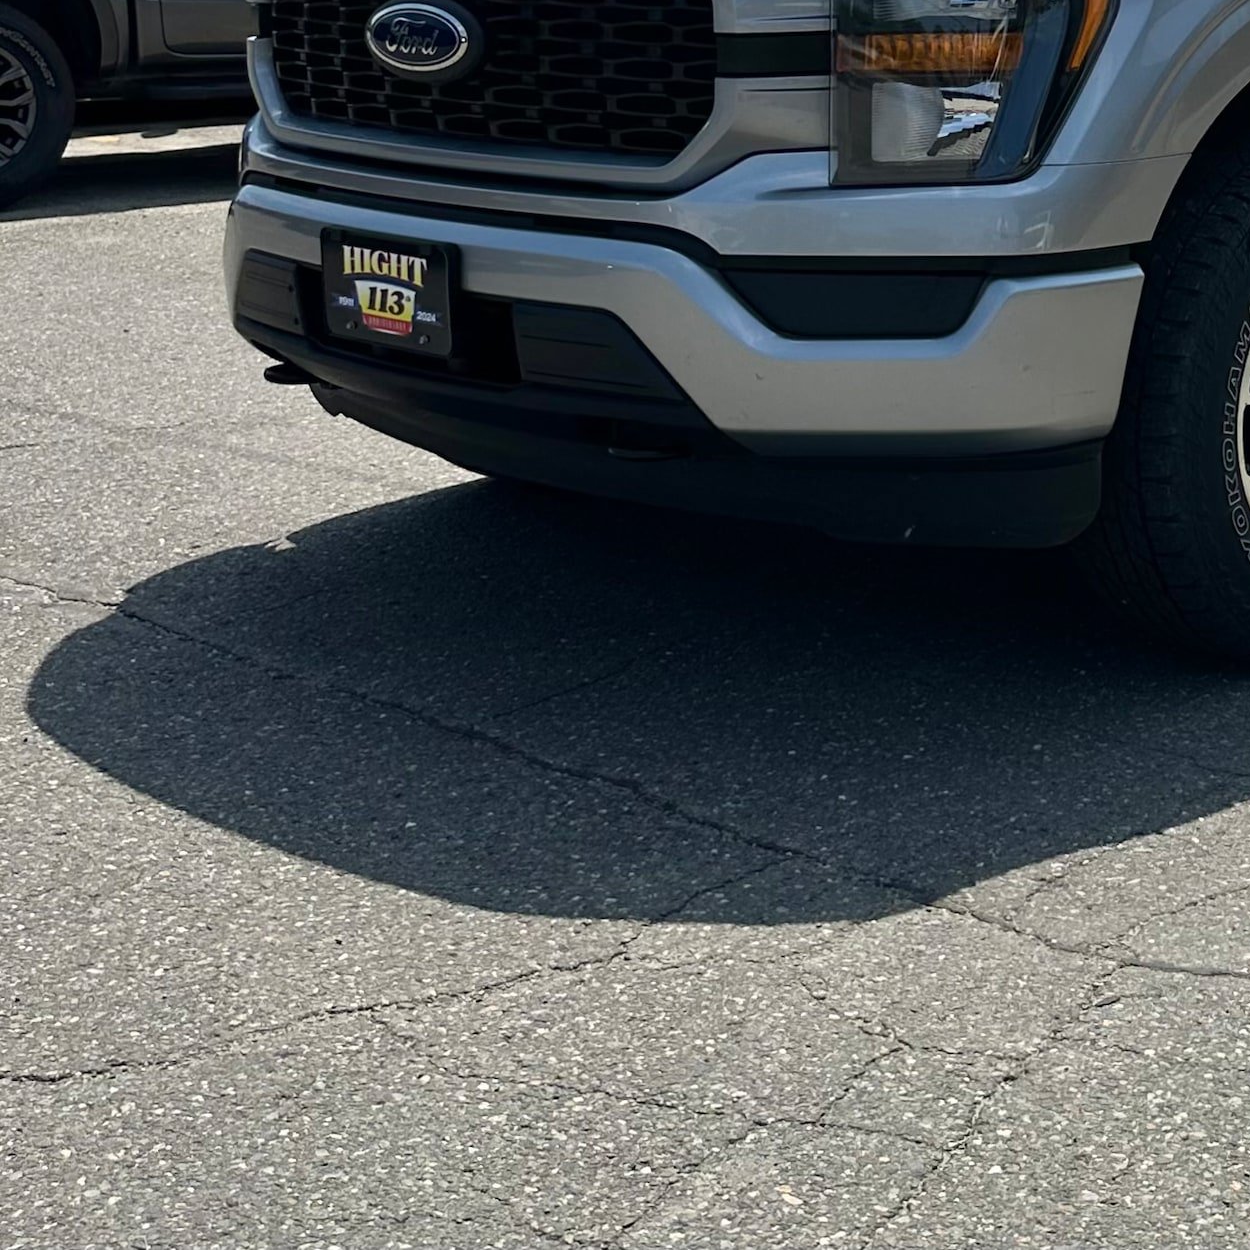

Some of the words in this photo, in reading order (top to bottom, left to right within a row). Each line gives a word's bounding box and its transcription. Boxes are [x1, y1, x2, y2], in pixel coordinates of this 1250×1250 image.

[385, 16, 439, 56] Ford
[342, 244, 428, 288] HIGHT
[416, 311, 436, 323] 2024
